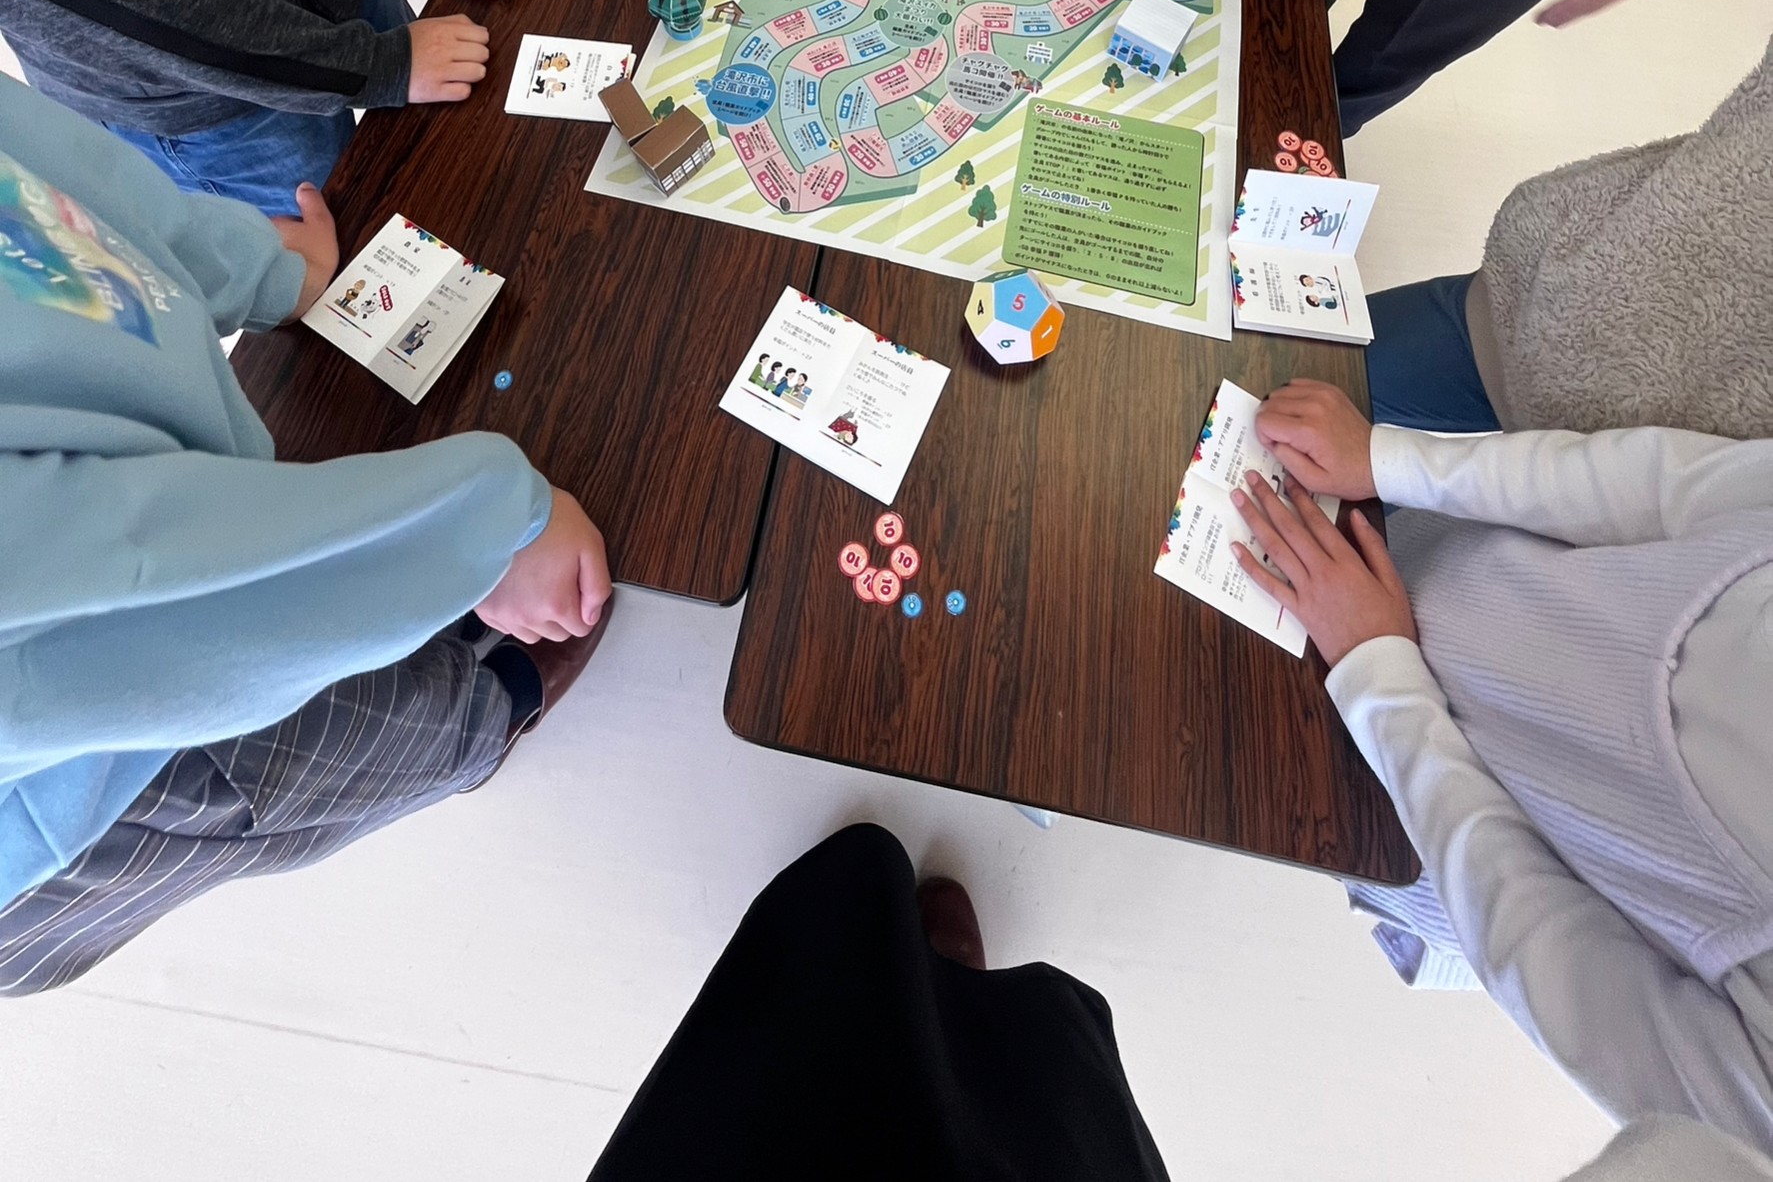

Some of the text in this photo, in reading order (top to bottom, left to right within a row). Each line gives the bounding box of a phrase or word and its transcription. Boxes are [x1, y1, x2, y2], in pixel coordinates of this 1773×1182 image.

[962, 57, 1009, 73] チャグチャグ
[723, 70, 770, 87] 滝沢市に
[1034, 104, 1120, 129] ゲームの基本ルール
[1284, 136, 1296, 146] 10
[1309, 145, 1318, 156] 10
[1280, 158, 1292, 167] 10
[1020, 183, 1110, 211] ゲームの特別ルール
[1012, 293, 1026, 311] 5
[794, 308, 836, 335] スーパーの店員
[870, 349, 914, 375] スーパーの店員
[1208, 415, 1234, 471] IT企業・アプリ開発
[884, 520, 895, 538] 10
[1177, 504, 1203, 565] IT企業・アプリ開発
[846, 551, 861, 568] 10
[898, 551, 913, 569] 10
[880, 579, 893, 596] 10
